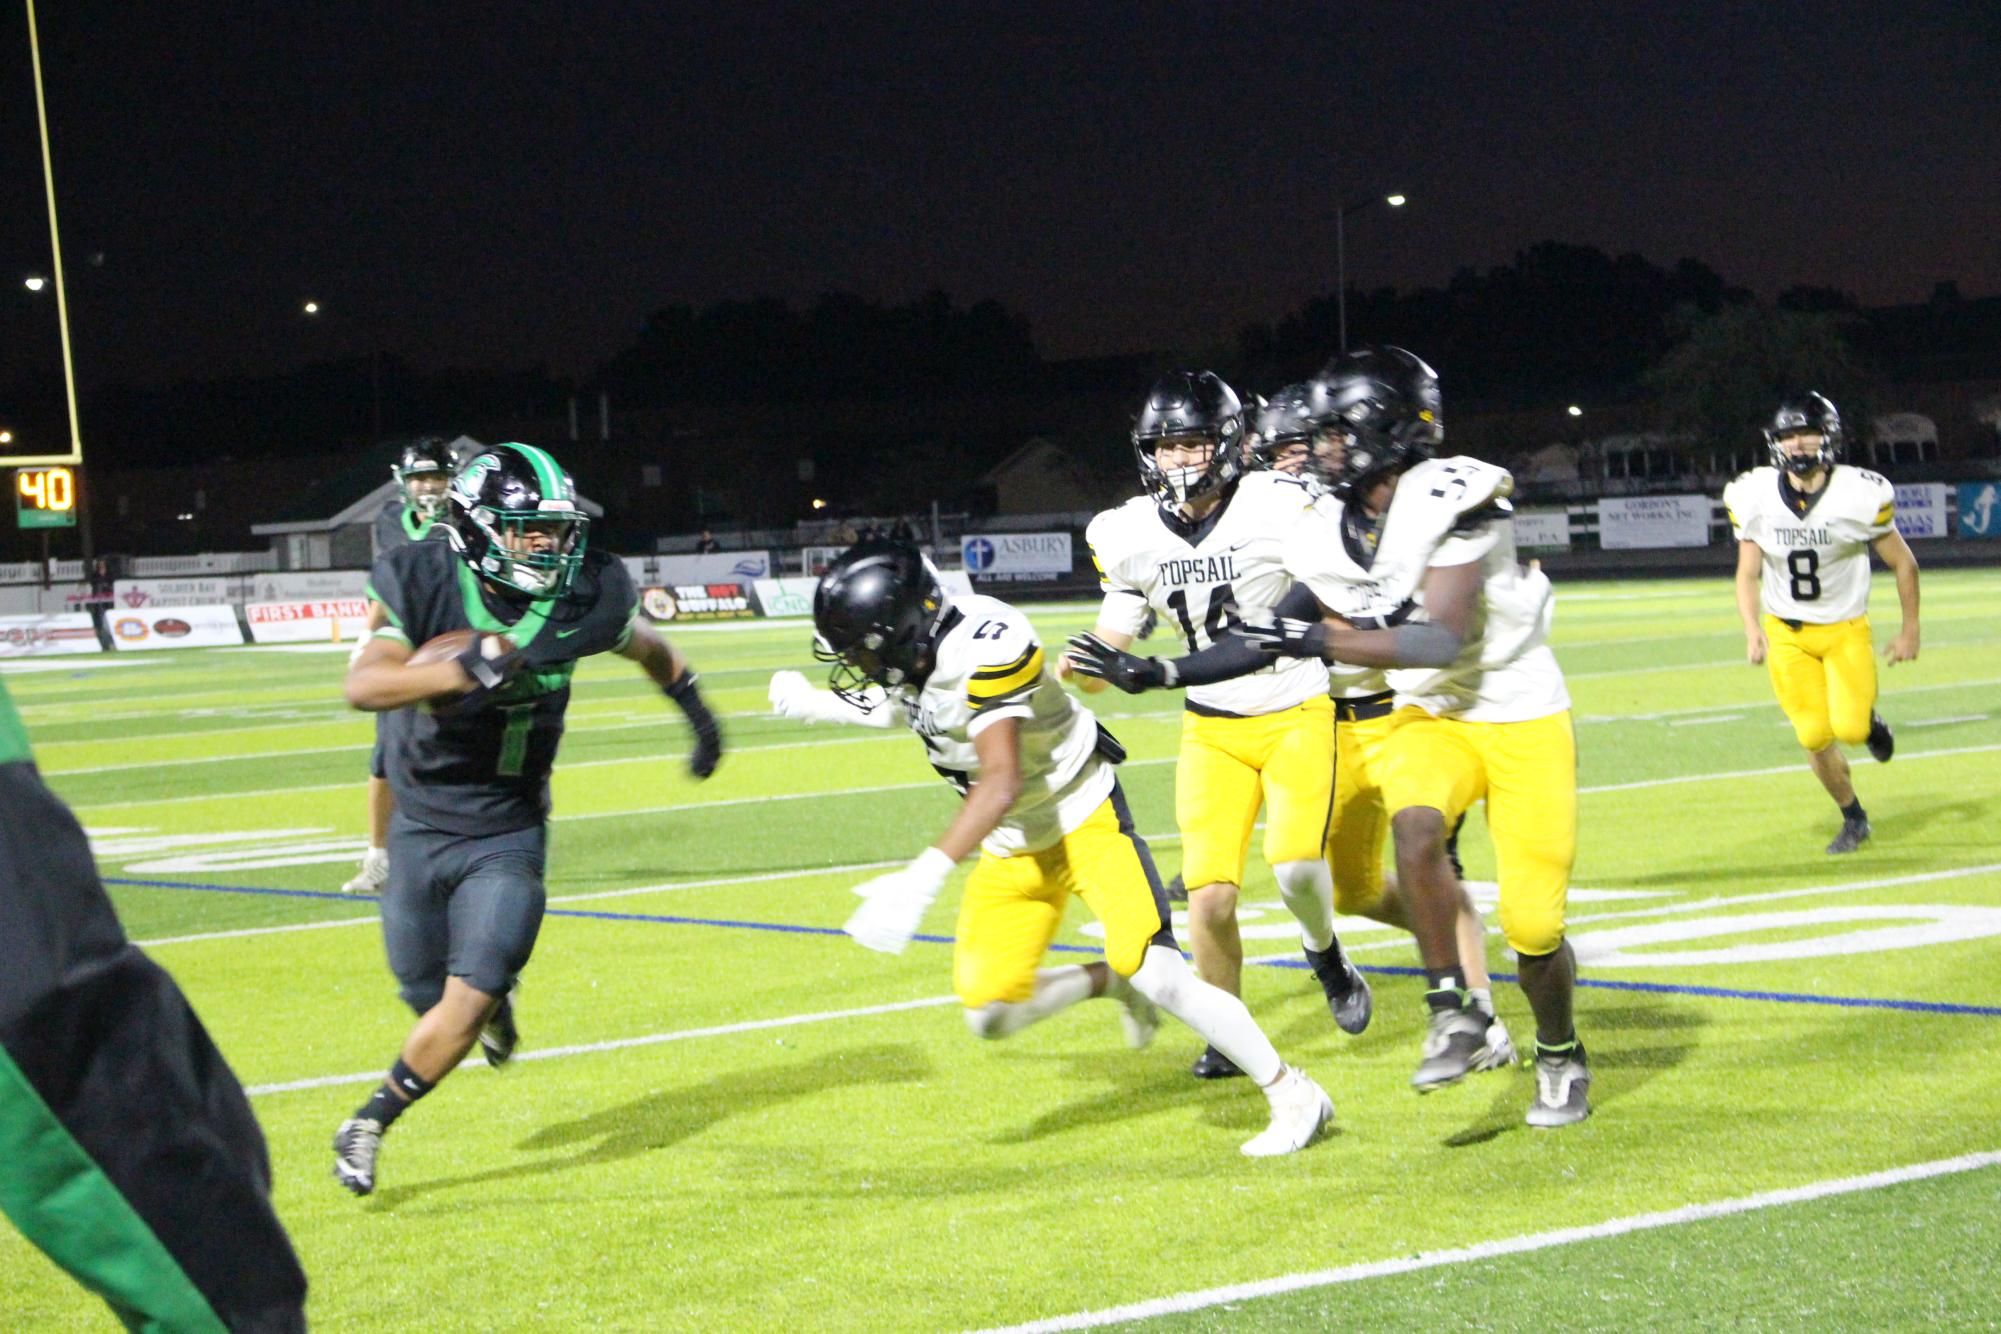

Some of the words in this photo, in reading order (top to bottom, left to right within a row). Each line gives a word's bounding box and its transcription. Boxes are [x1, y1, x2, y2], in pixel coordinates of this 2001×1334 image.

[20, 469, 71, 510] 40
[1001, 535, 1069, 554] ASBURY
[1775, 527, 1832, 546] TOPSAIL
[1159, 555, 1241, 586] TOPSAIL
[1788, 548, 1821, 602] 8
[250, 605, 304, 623] FIRST
[312, 602, 368, 618] BANK
